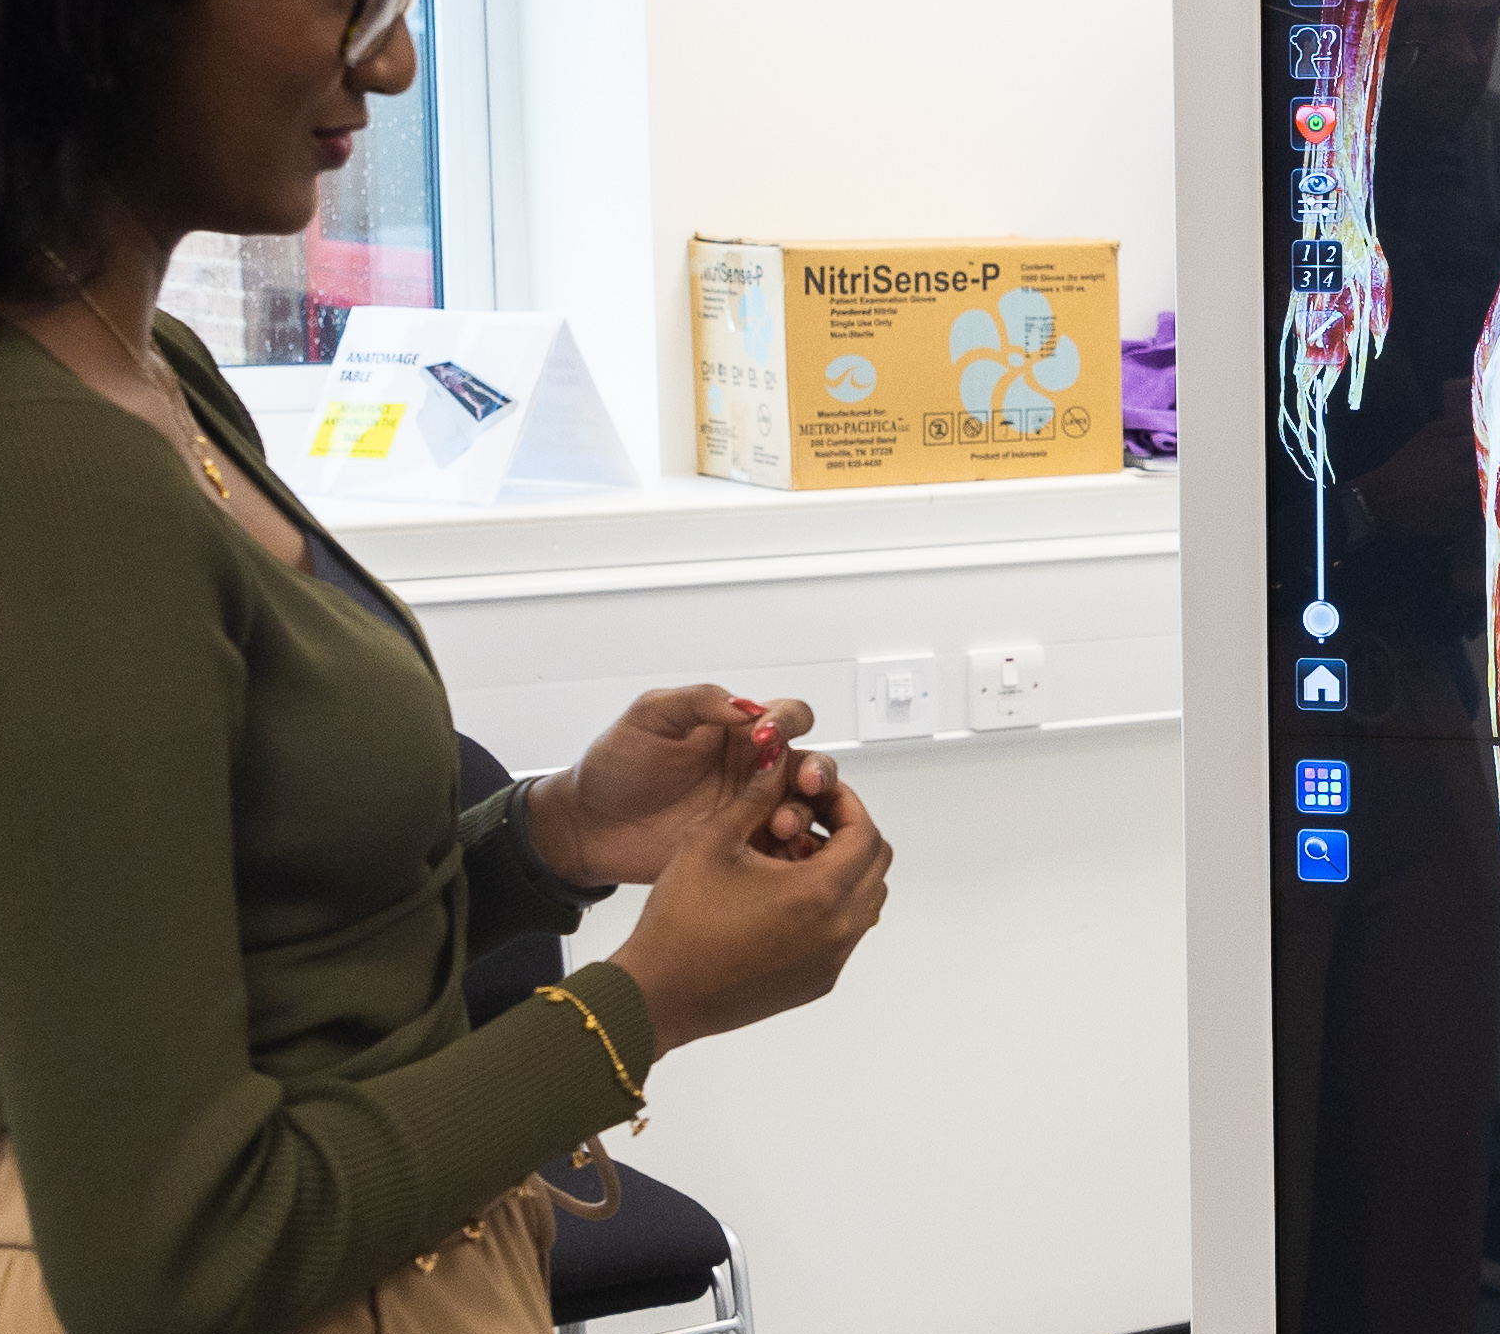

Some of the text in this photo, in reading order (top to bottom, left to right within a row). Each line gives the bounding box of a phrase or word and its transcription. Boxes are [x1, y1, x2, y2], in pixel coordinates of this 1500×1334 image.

[1301, 244, 1337, 263] 1 2
[804, 262, 1000, 295] NitriSense-P
[1300, 270, 1335, 288] 3 4
[346, 351, 420, 366] ANATOMAGE
[339, 370, 372, 383] TABLE
